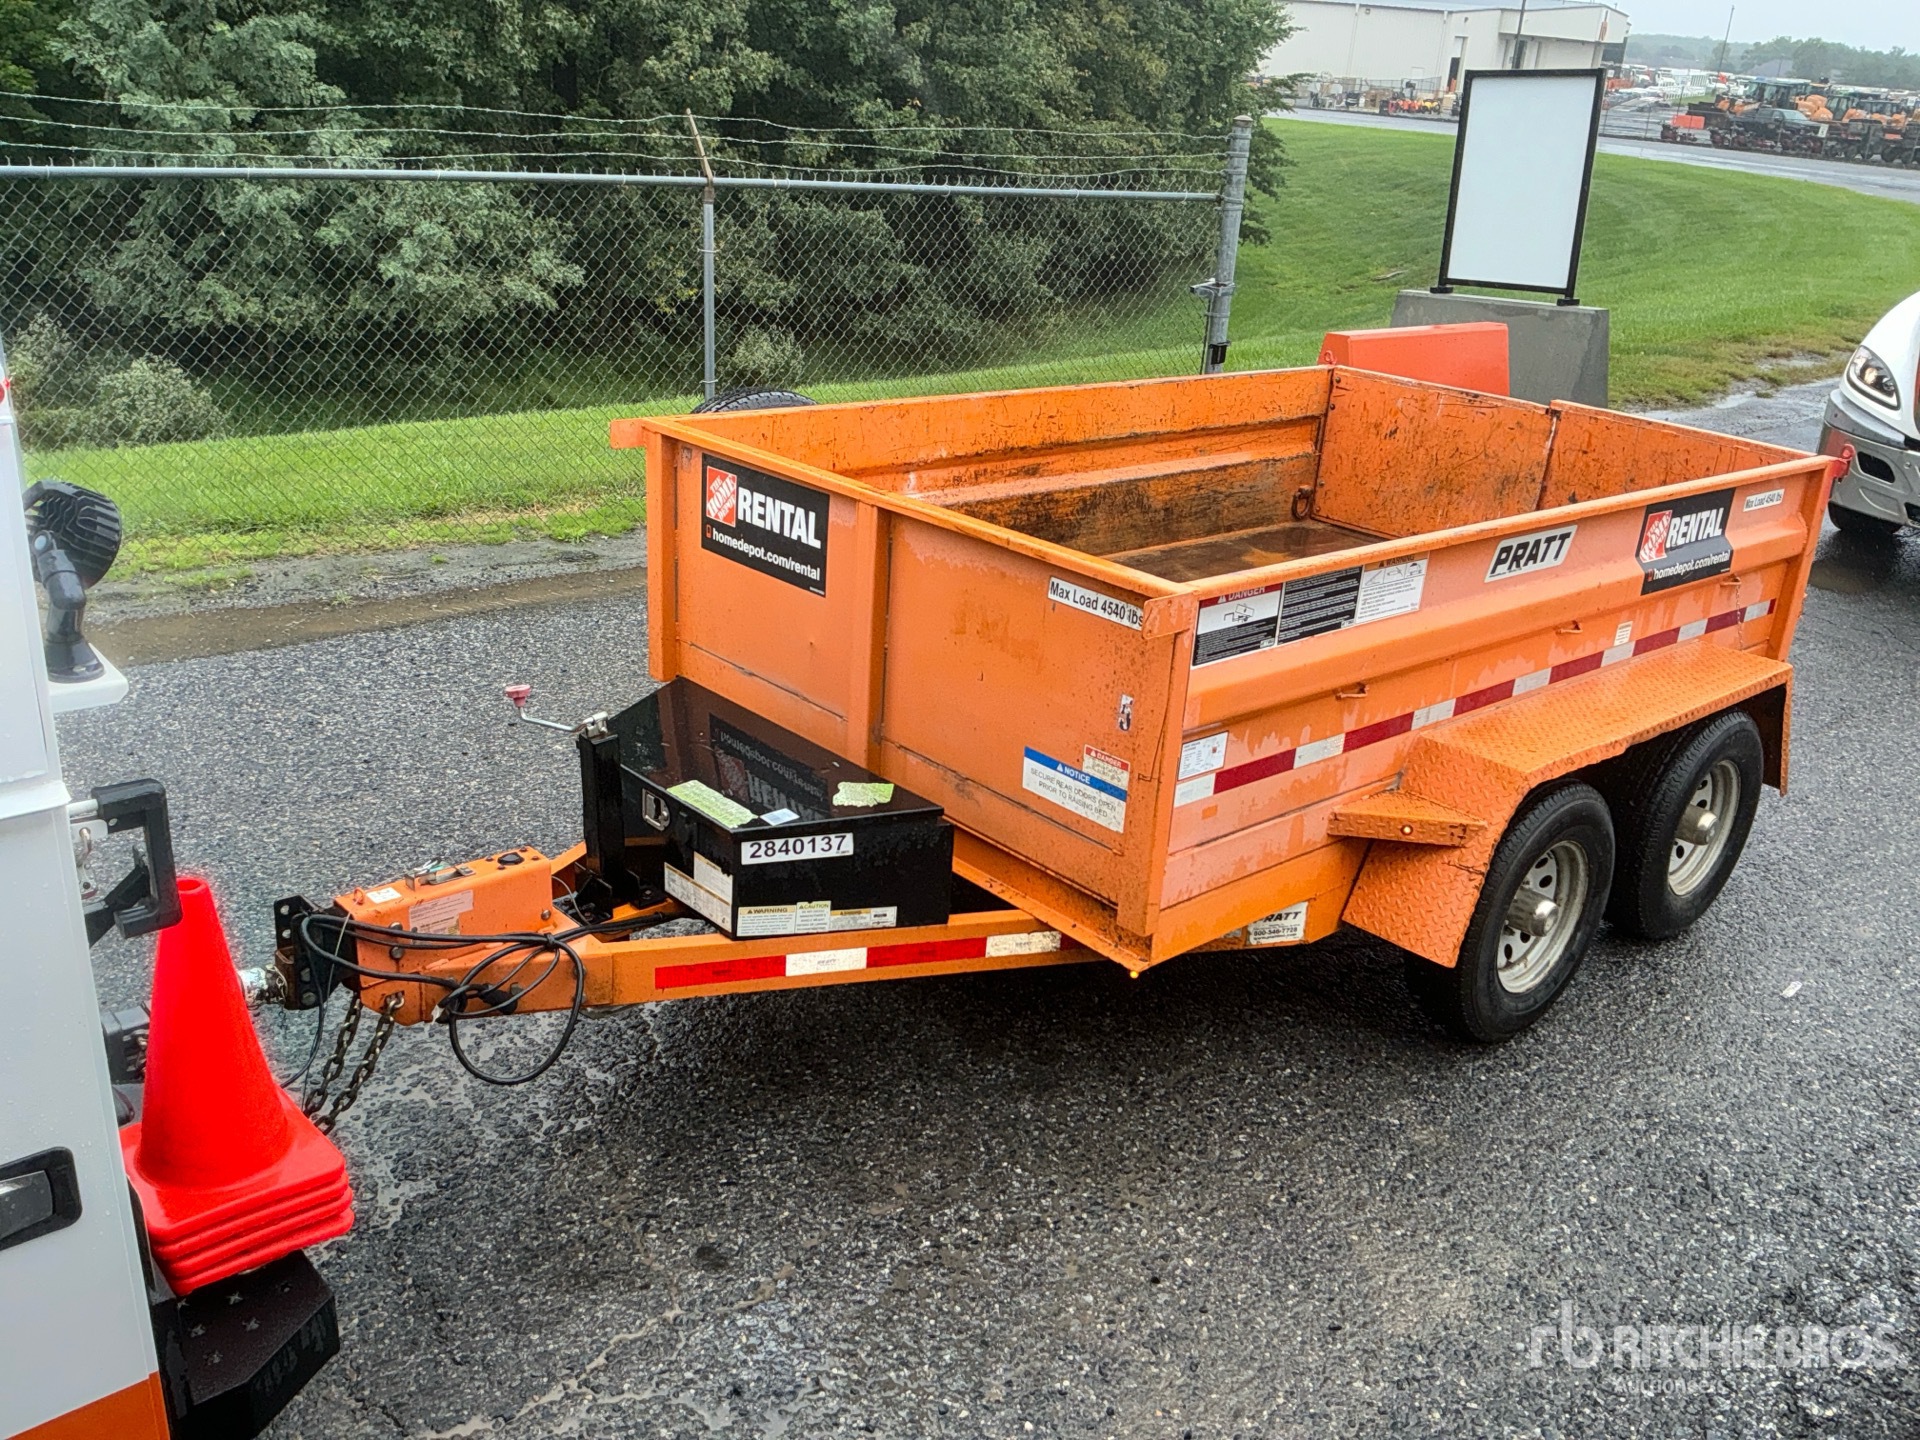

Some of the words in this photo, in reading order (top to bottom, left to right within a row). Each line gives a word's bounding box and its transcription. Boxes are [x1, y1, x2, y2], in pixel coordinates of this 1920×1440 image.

[706, 473, 736, 519] HOME
[738, 487, 821, 549] RENTAL
[1666, 507, 1724, 548] RENTAL
[713, 528, 820, 581] homedepot.com/rental
[1490, 531, 1572, 574] PRATT
[1653, 550, 1730, 580] homedepot.com/rental
[1050, 581, 1070, 601] Max
[1073, 589, 1098, 611] Load
[1101, 600, 1126, 620] 4540
[1128, 609, 1143, 627] lbs
[1064, 766, 1091, 785] NOTICE
[1096, 752, 1122, 769] DANGER
[1030, 768, 1056, 785] SECURE
[1056, 780, 1073, 792] REAR
[1098, 798, 1117, 812] OPEN
[1038, 781, 1057, 794] PRIOR
[1059, 790, 1067, 799] TO
[1094, 807, 1108, 817] BED
[750, 835, 847, 859] 2840137
